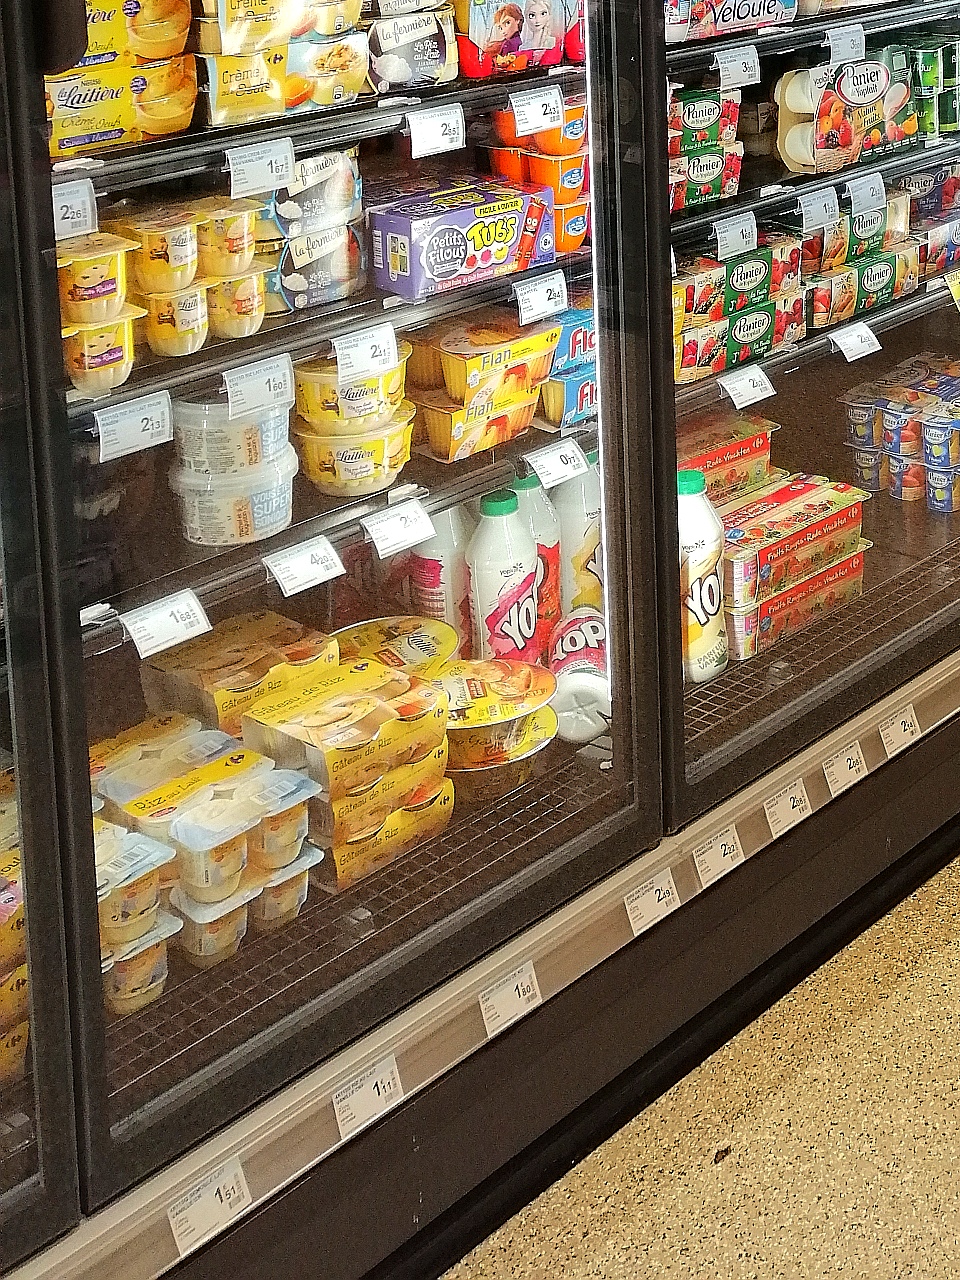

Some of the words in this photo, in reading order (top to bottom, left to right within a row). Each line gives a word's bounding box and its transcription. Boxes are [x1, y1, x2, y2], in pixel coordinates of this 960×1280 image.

[222, 68, 260, 85] Crème
[849, 64, 881, 86] Panier
[60, 86, 123, 110] Laitière
[685, 103, 720, 120] Panier
[689, 157, 722, 174] Panier
[432, 231, 463, 248] Petits
[429, 242, 466, 265] Filous
[733, 262, 768, 283] Panier
[734, 314, 770, 335] Panier
[482, 348, 511, 371] Flan
[466, 400, 493, 420] Flan
[135, 794, 165, 813] Riz
